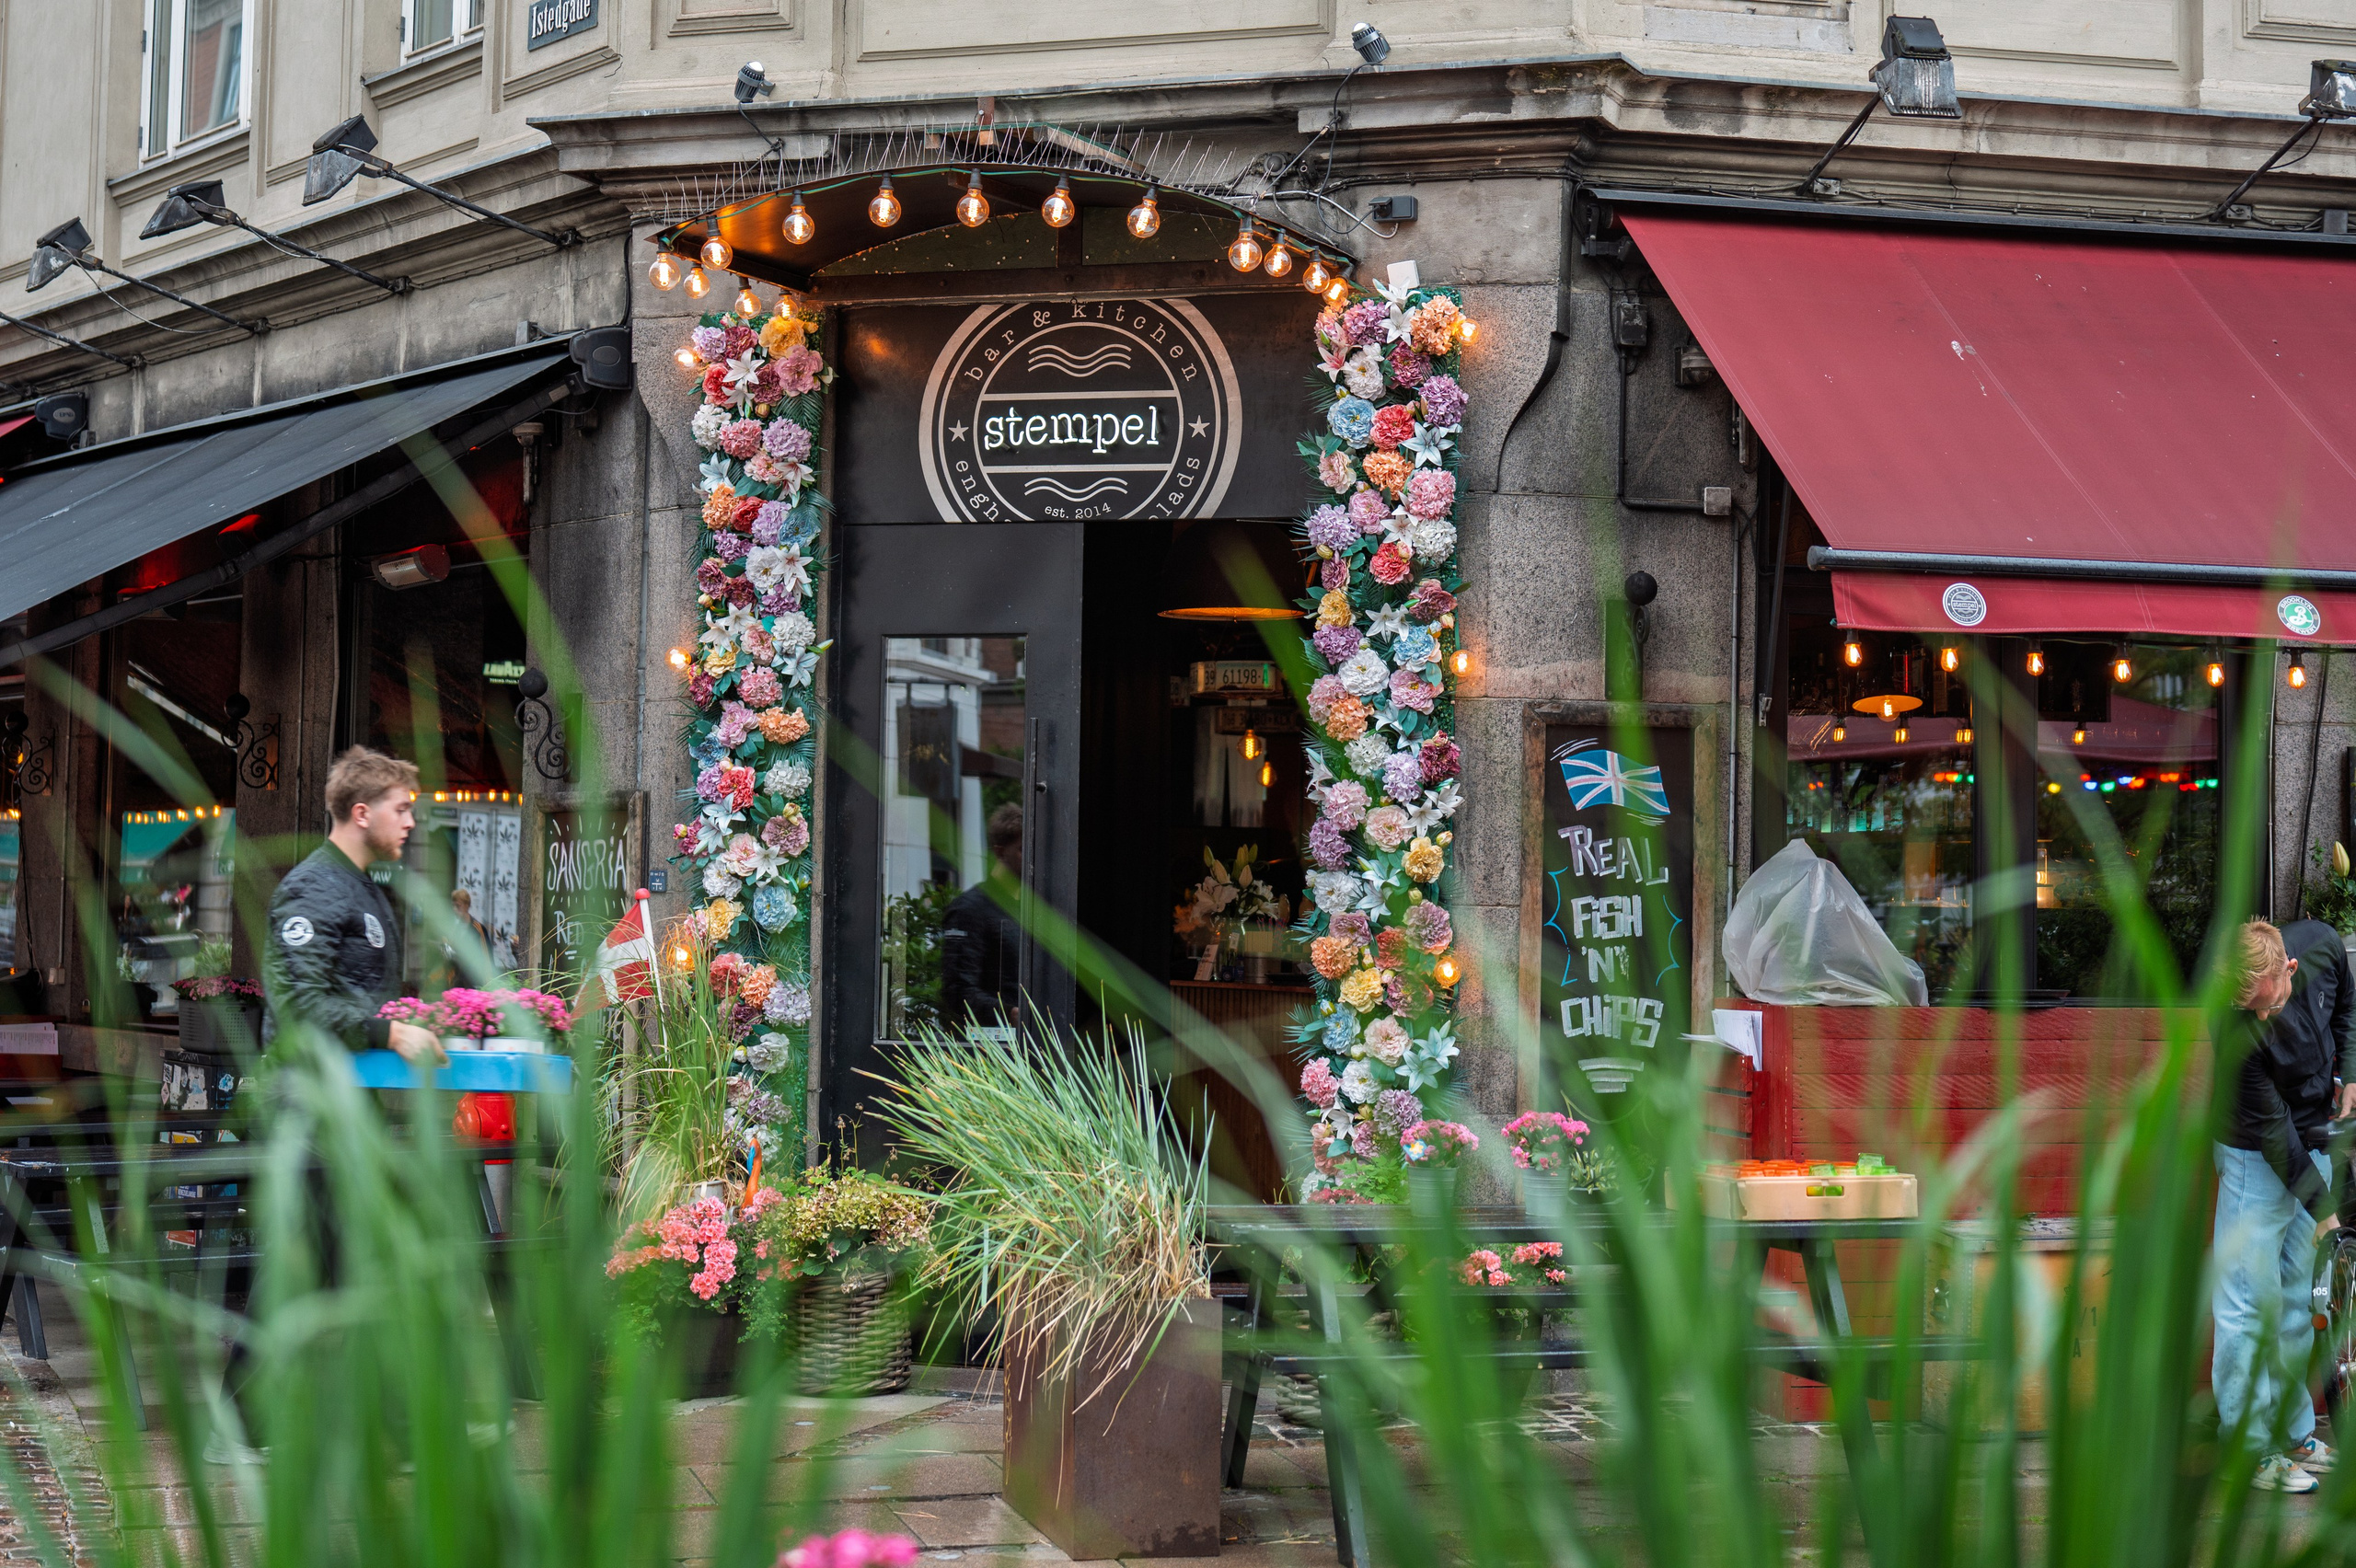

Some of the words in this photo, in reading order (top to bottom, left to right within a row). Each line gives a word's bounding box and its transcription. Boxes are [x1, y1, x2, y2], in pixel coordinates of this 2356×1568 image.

[964, 329, 1014, 381] bar
[1033, 310, 1051, 328] &
[1072, 302, 1198, 382] kitchen
[984, 406, 1160, 454] stempel
[955, 460, 1011, 523] engh
[1148, 457, 1200, 520] lads
[1044, 504, 1070, 519] est.
[1075, 502, 1112, 520] 2014
[2280, 597, 2313, 609] BROOKLYN
[1557, 824, 1669, 886] REAL
[2312, 1286, 2328, 1297] 105
